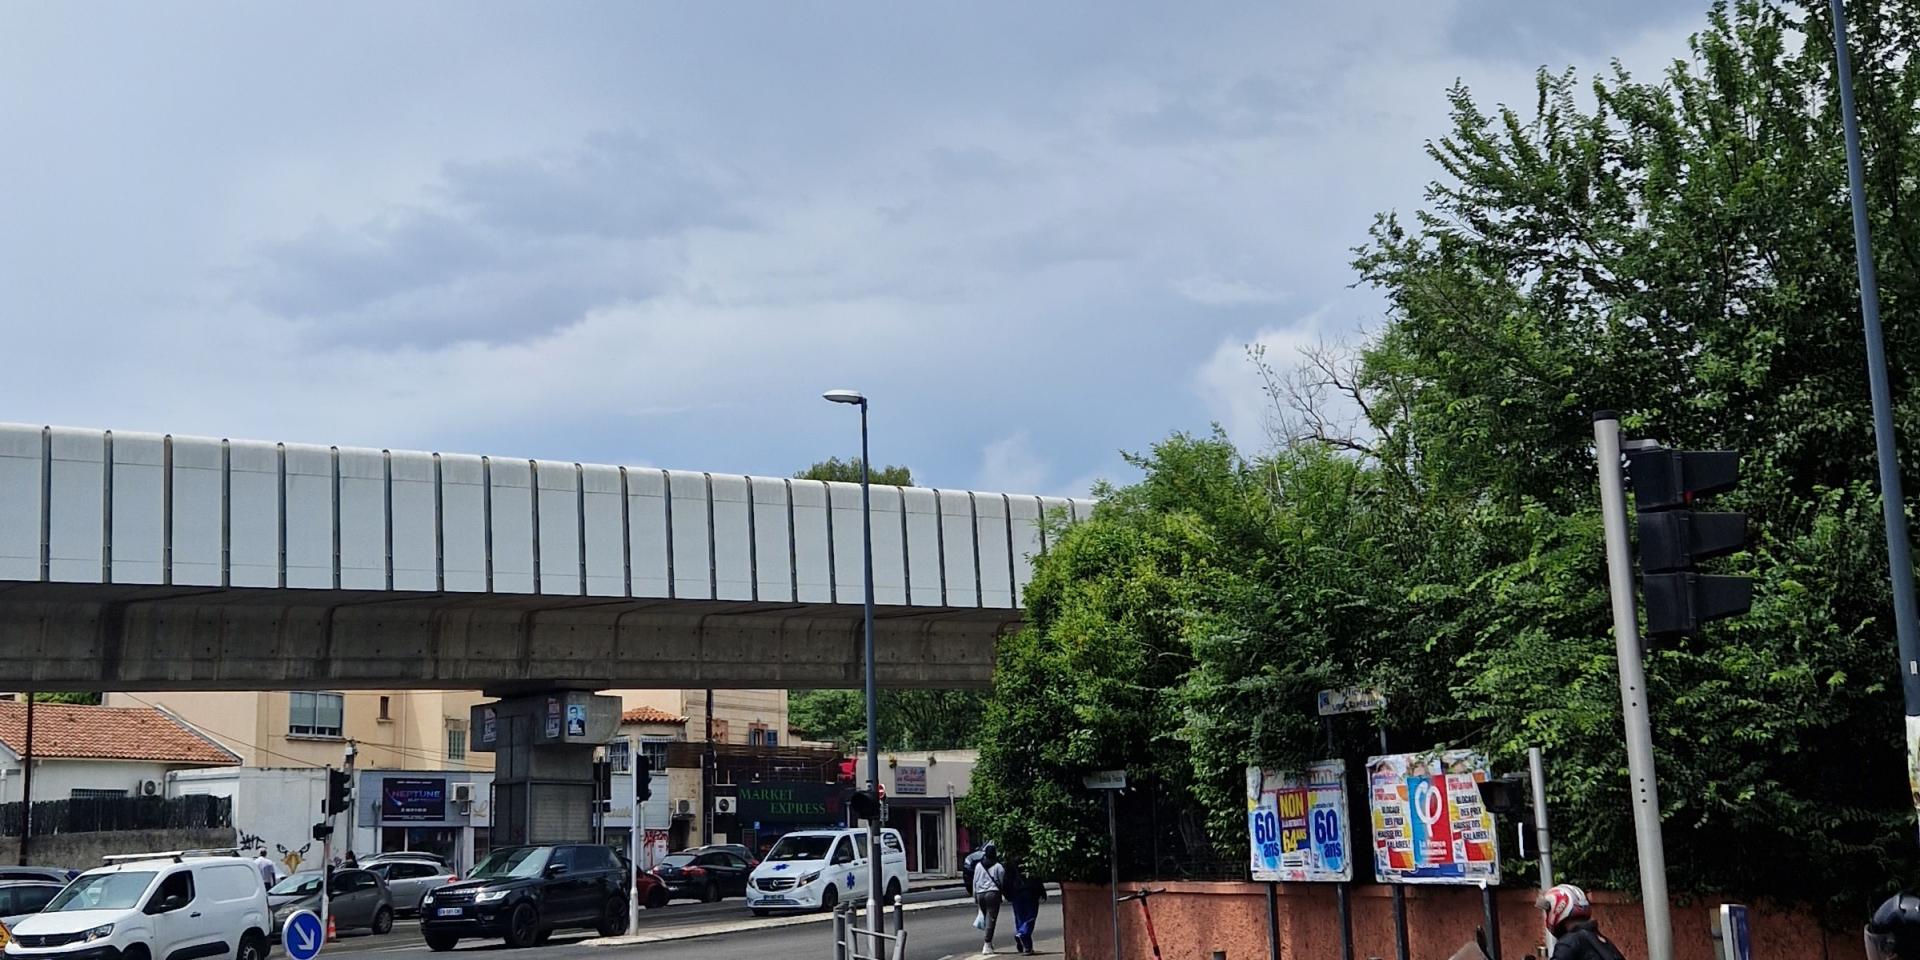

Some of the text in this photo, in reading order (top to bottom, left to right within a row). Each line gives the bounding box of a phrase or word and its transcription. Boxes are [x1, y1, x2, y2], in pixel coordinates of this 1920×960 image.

[391, 790, 441, 798] NEPTUNE
[740, 789, 793, 800] MARKET
[770, 802, 826, 814] EXPRESS
[1280, 793, 1304, 818] NON
[1461, 807, 1470, 816] DES
[1254, 811, 1277, 845] 60
[1314, 809, 1339, 845] 60
[1282, 829, 1298, 852] 64
[1264, 842, 1280, 858] ans
[1324, 842, 1342, 858] ans
